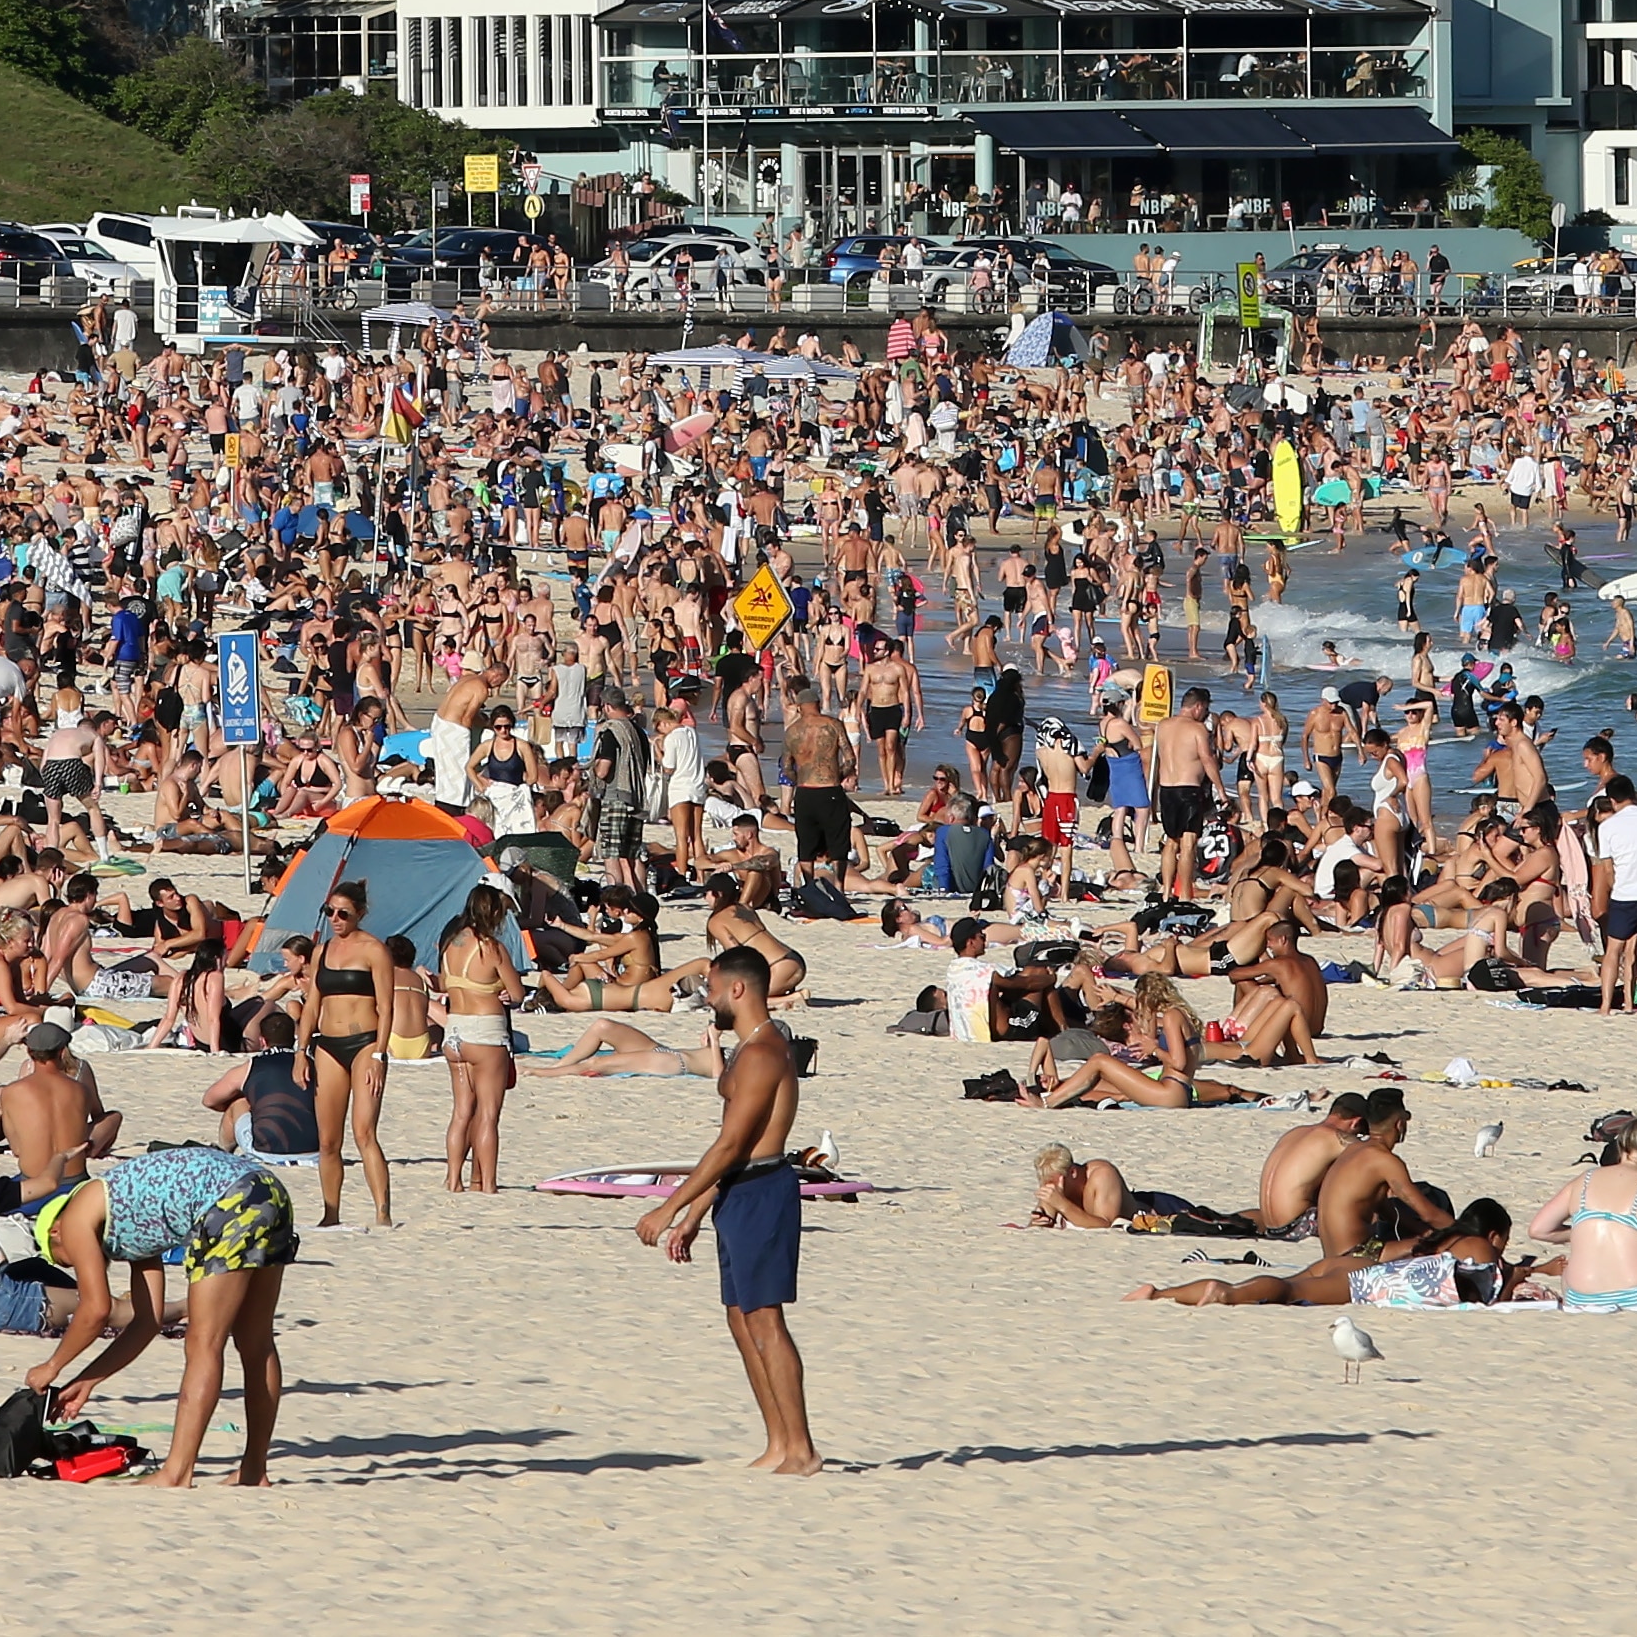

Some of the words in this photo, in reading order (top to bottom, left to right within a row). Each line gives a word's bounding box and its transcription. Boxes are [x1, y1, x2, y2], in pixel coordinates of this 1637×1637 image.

[942, 201, 968, 218] NBF
[1036, 201, 1064, 217] NBF
[1244, 197, 1271, 213] NBF
[1348, 196, 1376, 212] NBF
[1198, 834, 1230, 859] 23
